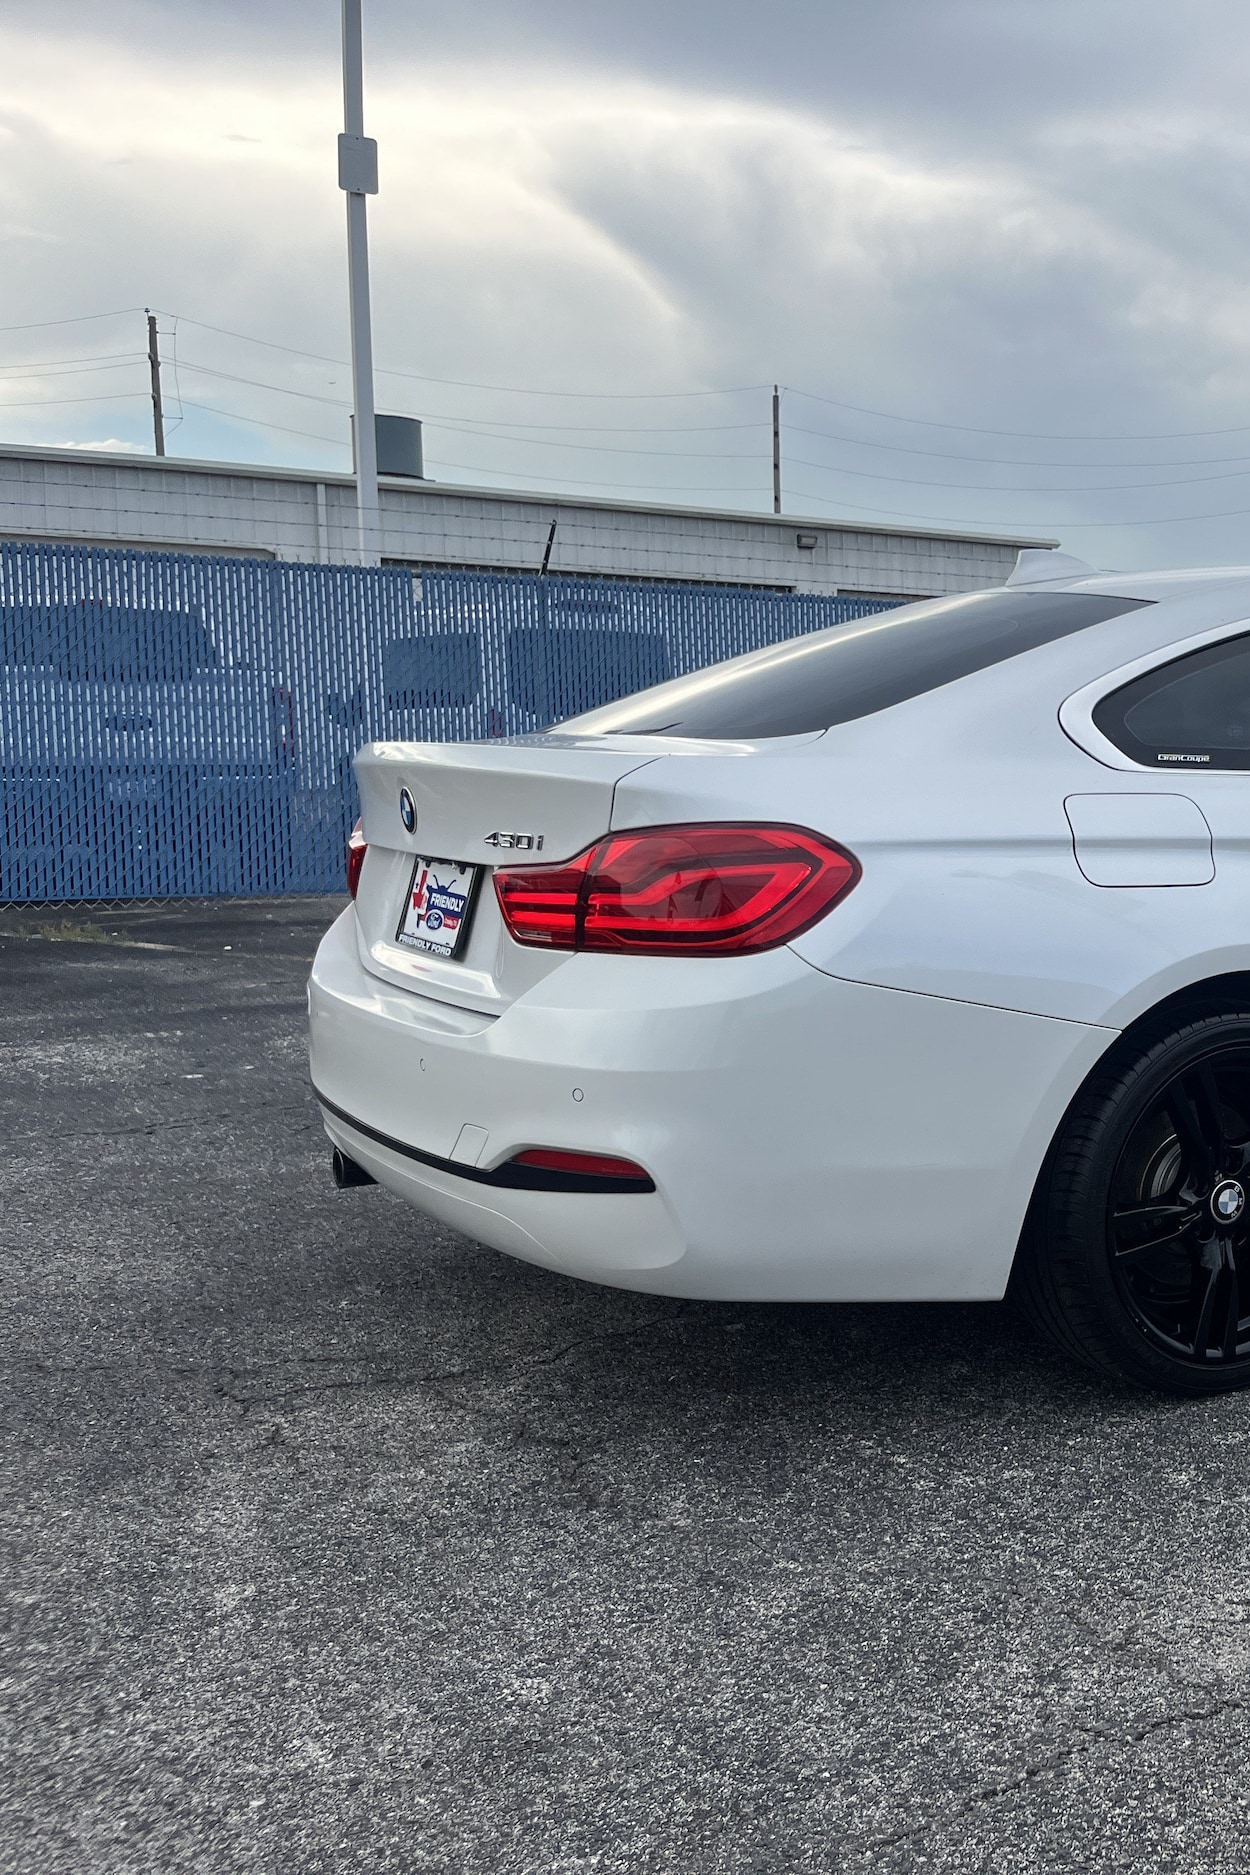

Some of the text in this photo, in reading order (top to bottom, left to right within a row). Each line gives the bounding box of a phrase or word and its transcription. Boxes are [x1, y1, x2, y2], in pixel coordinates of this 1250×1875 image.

[430, 892, 465, 913] FRIENDLY
[399, 933, 452, 956] FRIENDLY FORD
